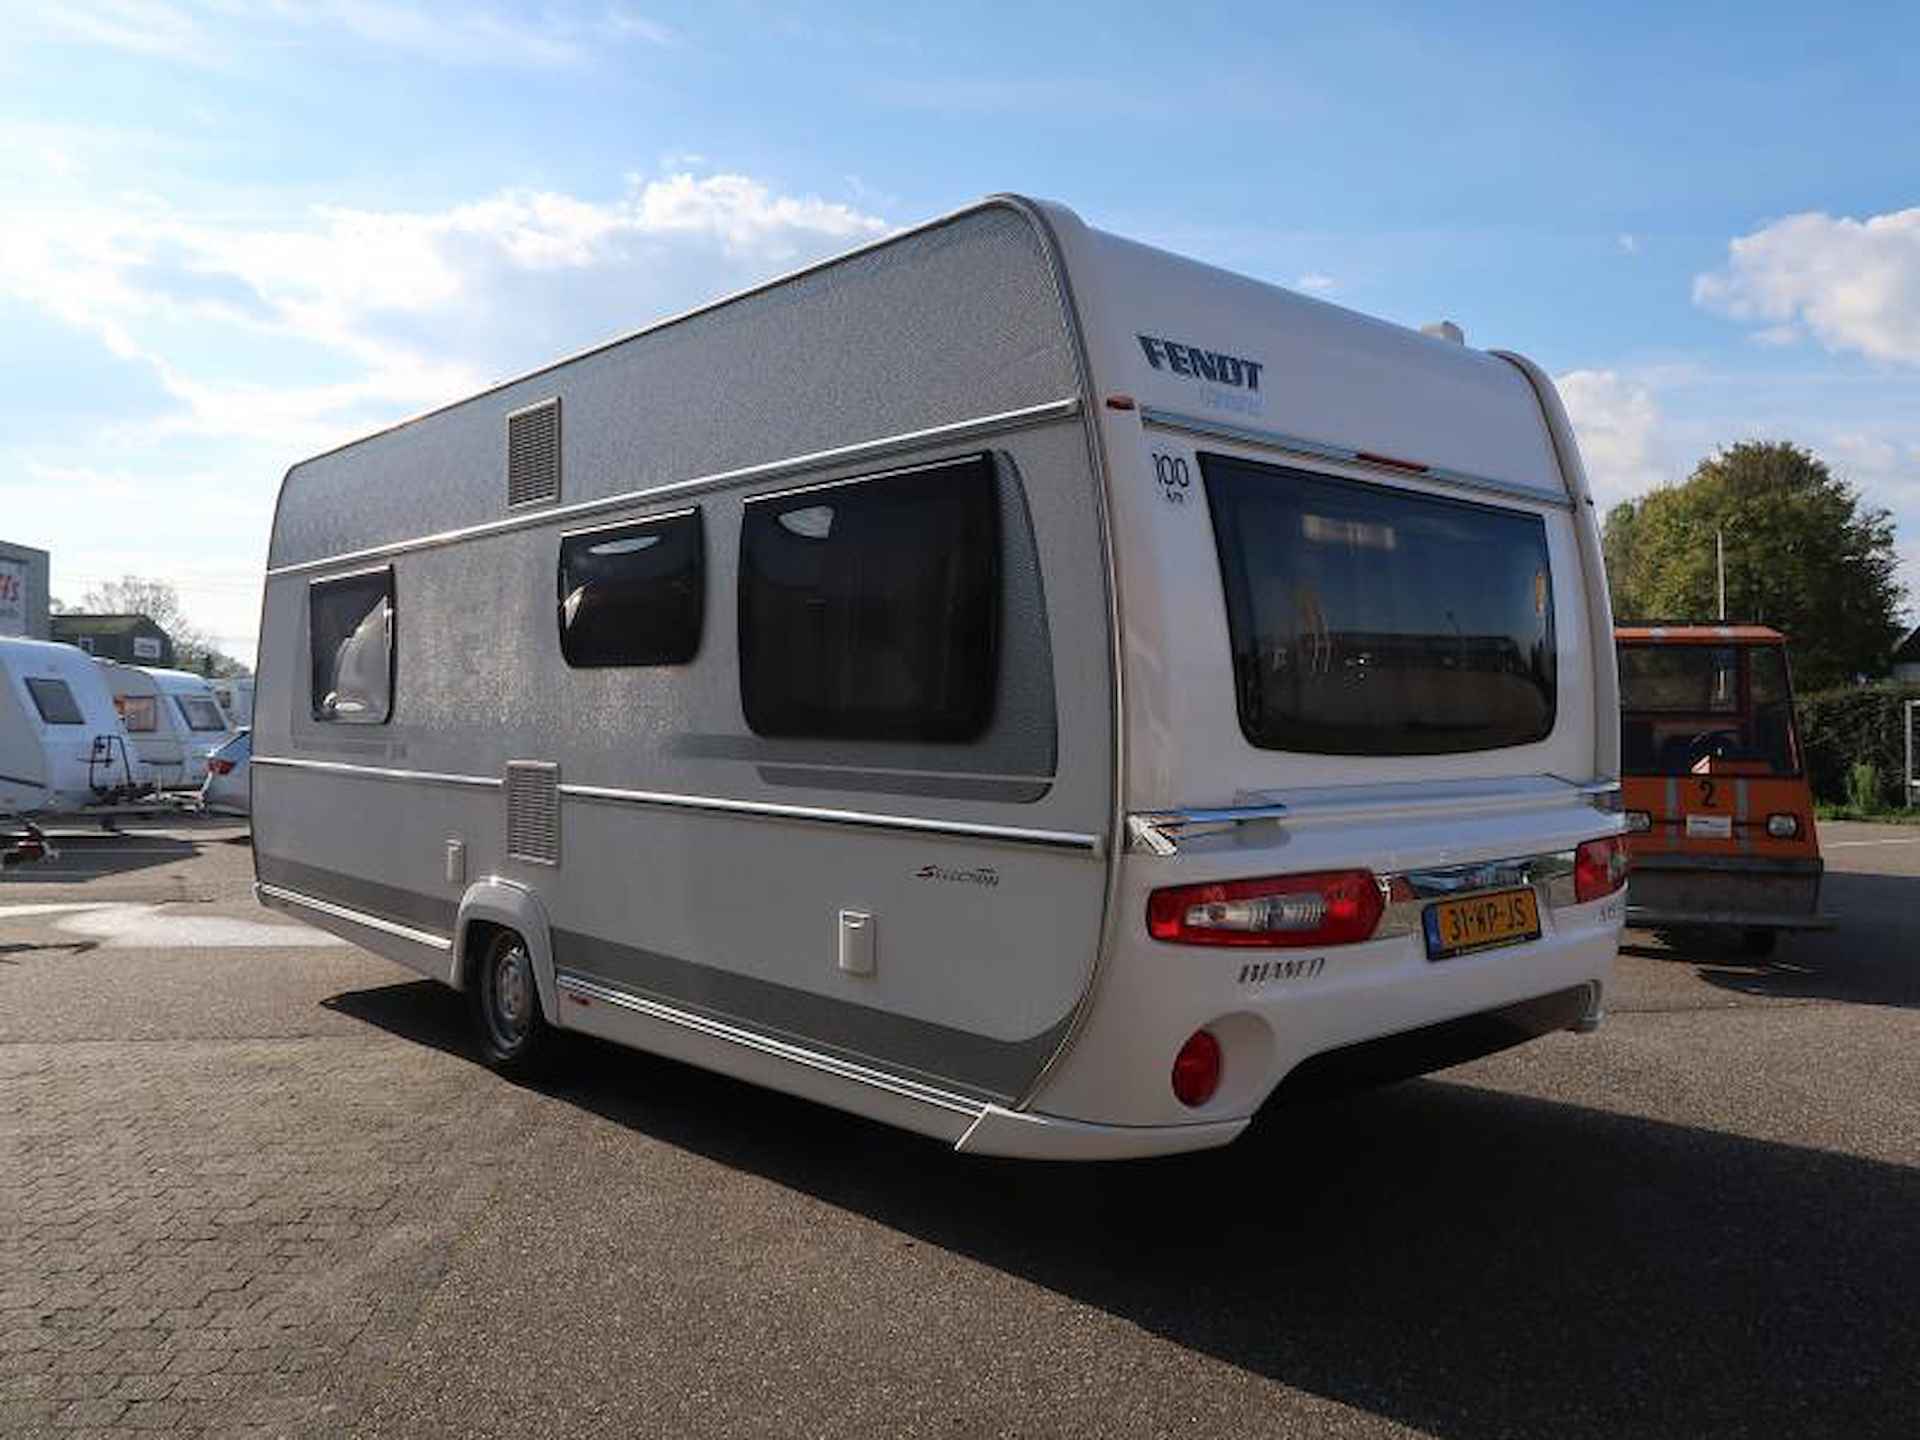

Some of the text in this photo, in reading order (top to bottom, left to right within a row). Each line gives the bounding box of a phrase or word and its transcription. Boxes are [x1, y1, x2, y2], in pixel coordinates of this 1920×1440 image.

[1136, 334, 1263, 391] FENDT
[1152, 453, 1189, 488] 100
[1699, 780, 1716, 807] 2
